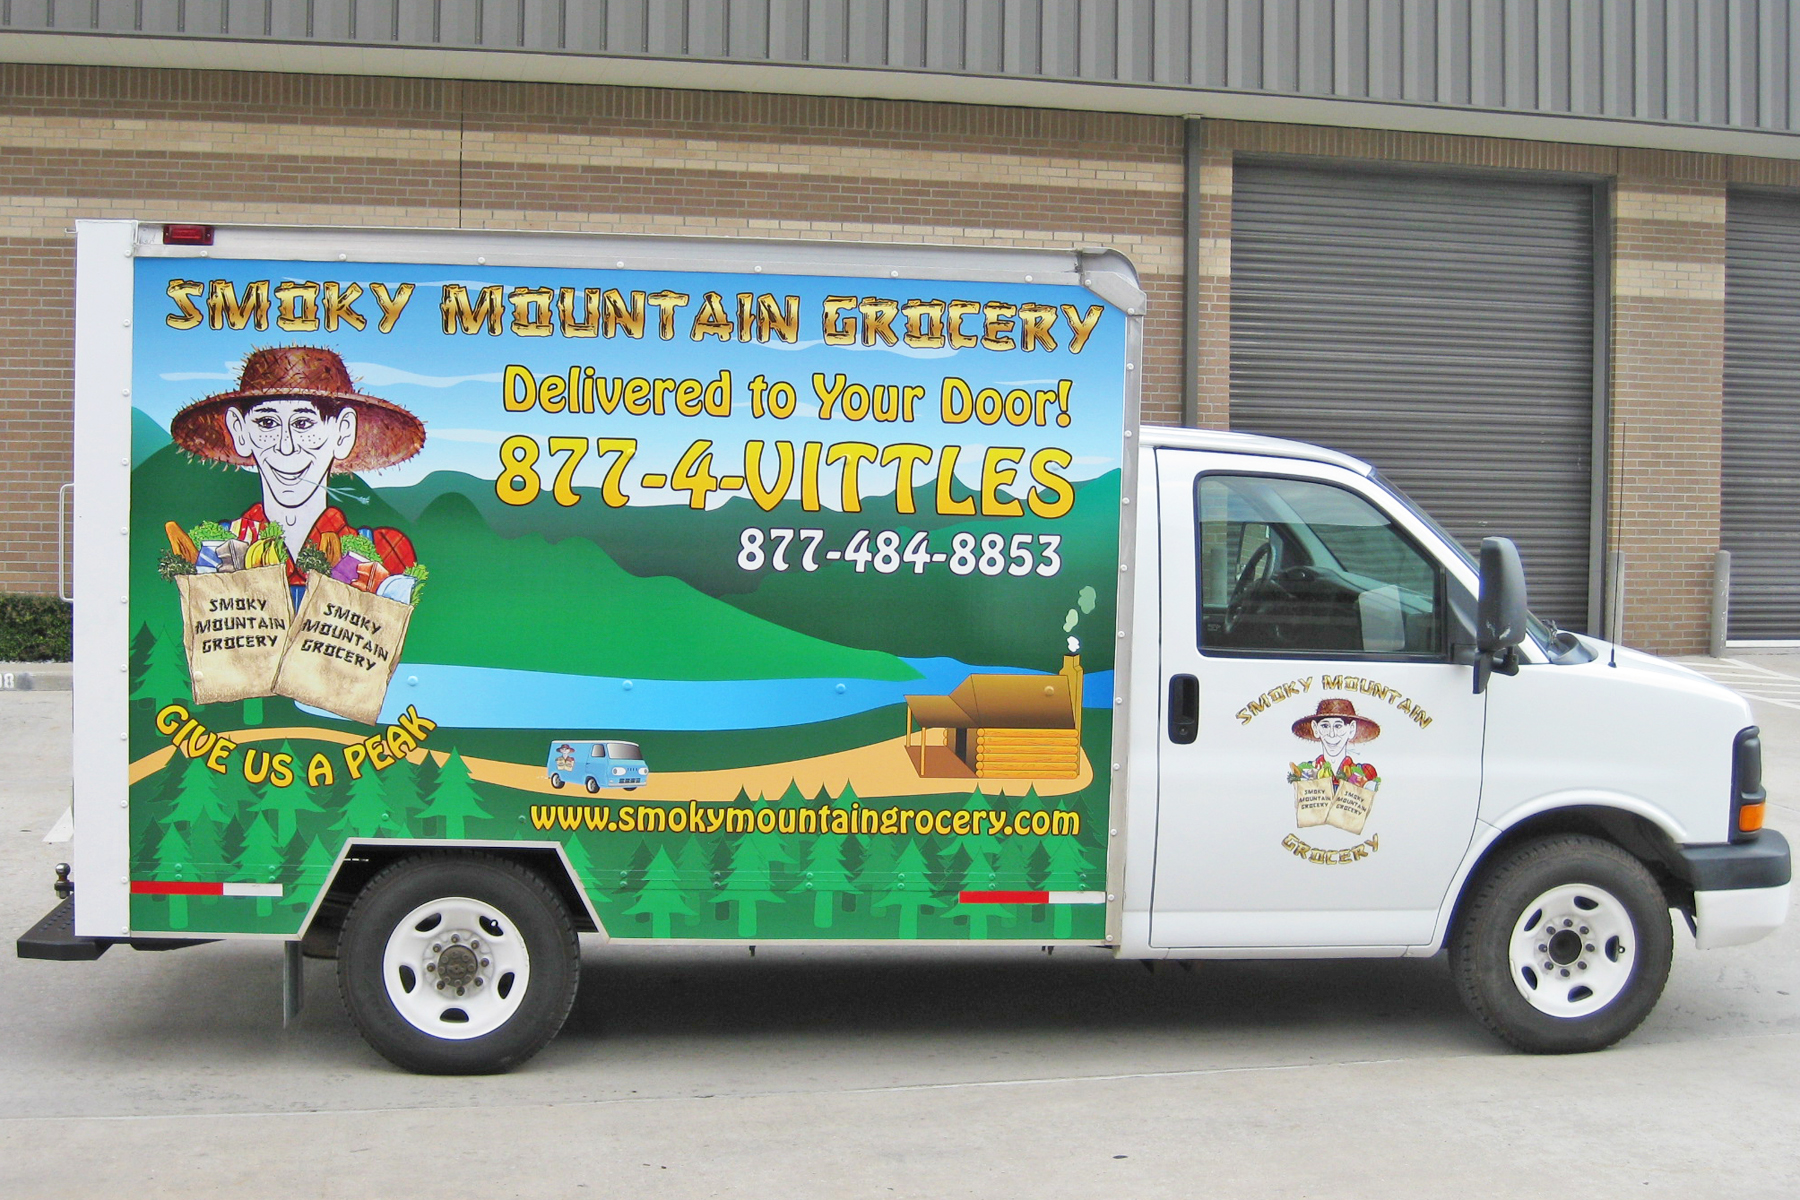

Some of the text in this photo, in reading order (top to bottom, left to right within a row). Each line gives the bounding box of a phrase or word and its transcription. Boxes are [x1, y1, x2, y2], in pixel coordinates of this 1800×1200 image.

[166, 279, 1104, 354] SMOKY MOUNTAIN GROCERY
[503, 364, 1073, 427] Delivered to Your Door!
[495, 435, 1075, 518] 877-4-VITTLES
[737, 527, 1062, 577] 877-484-8853
[209, 597, 267, 612] SMOKY
[323, 602, 381, 635] SMOKY
[195, 616, 286, 634] MOUNTAIN
[202, 635, 278, 653] GROCERY
[301, 619, 388, 662] MOUNTAIN
[301, 639, 376, 671] GROCERY
[1235, 674, 1433, 730] SMOKY MOUNTAIN
[155, 704, 437, 788] GIVE US A PEAK
[529, 800, 1080, 836] www.smokymountaingrocery.com
[1281, 833, 1379, 865] GROCERY
